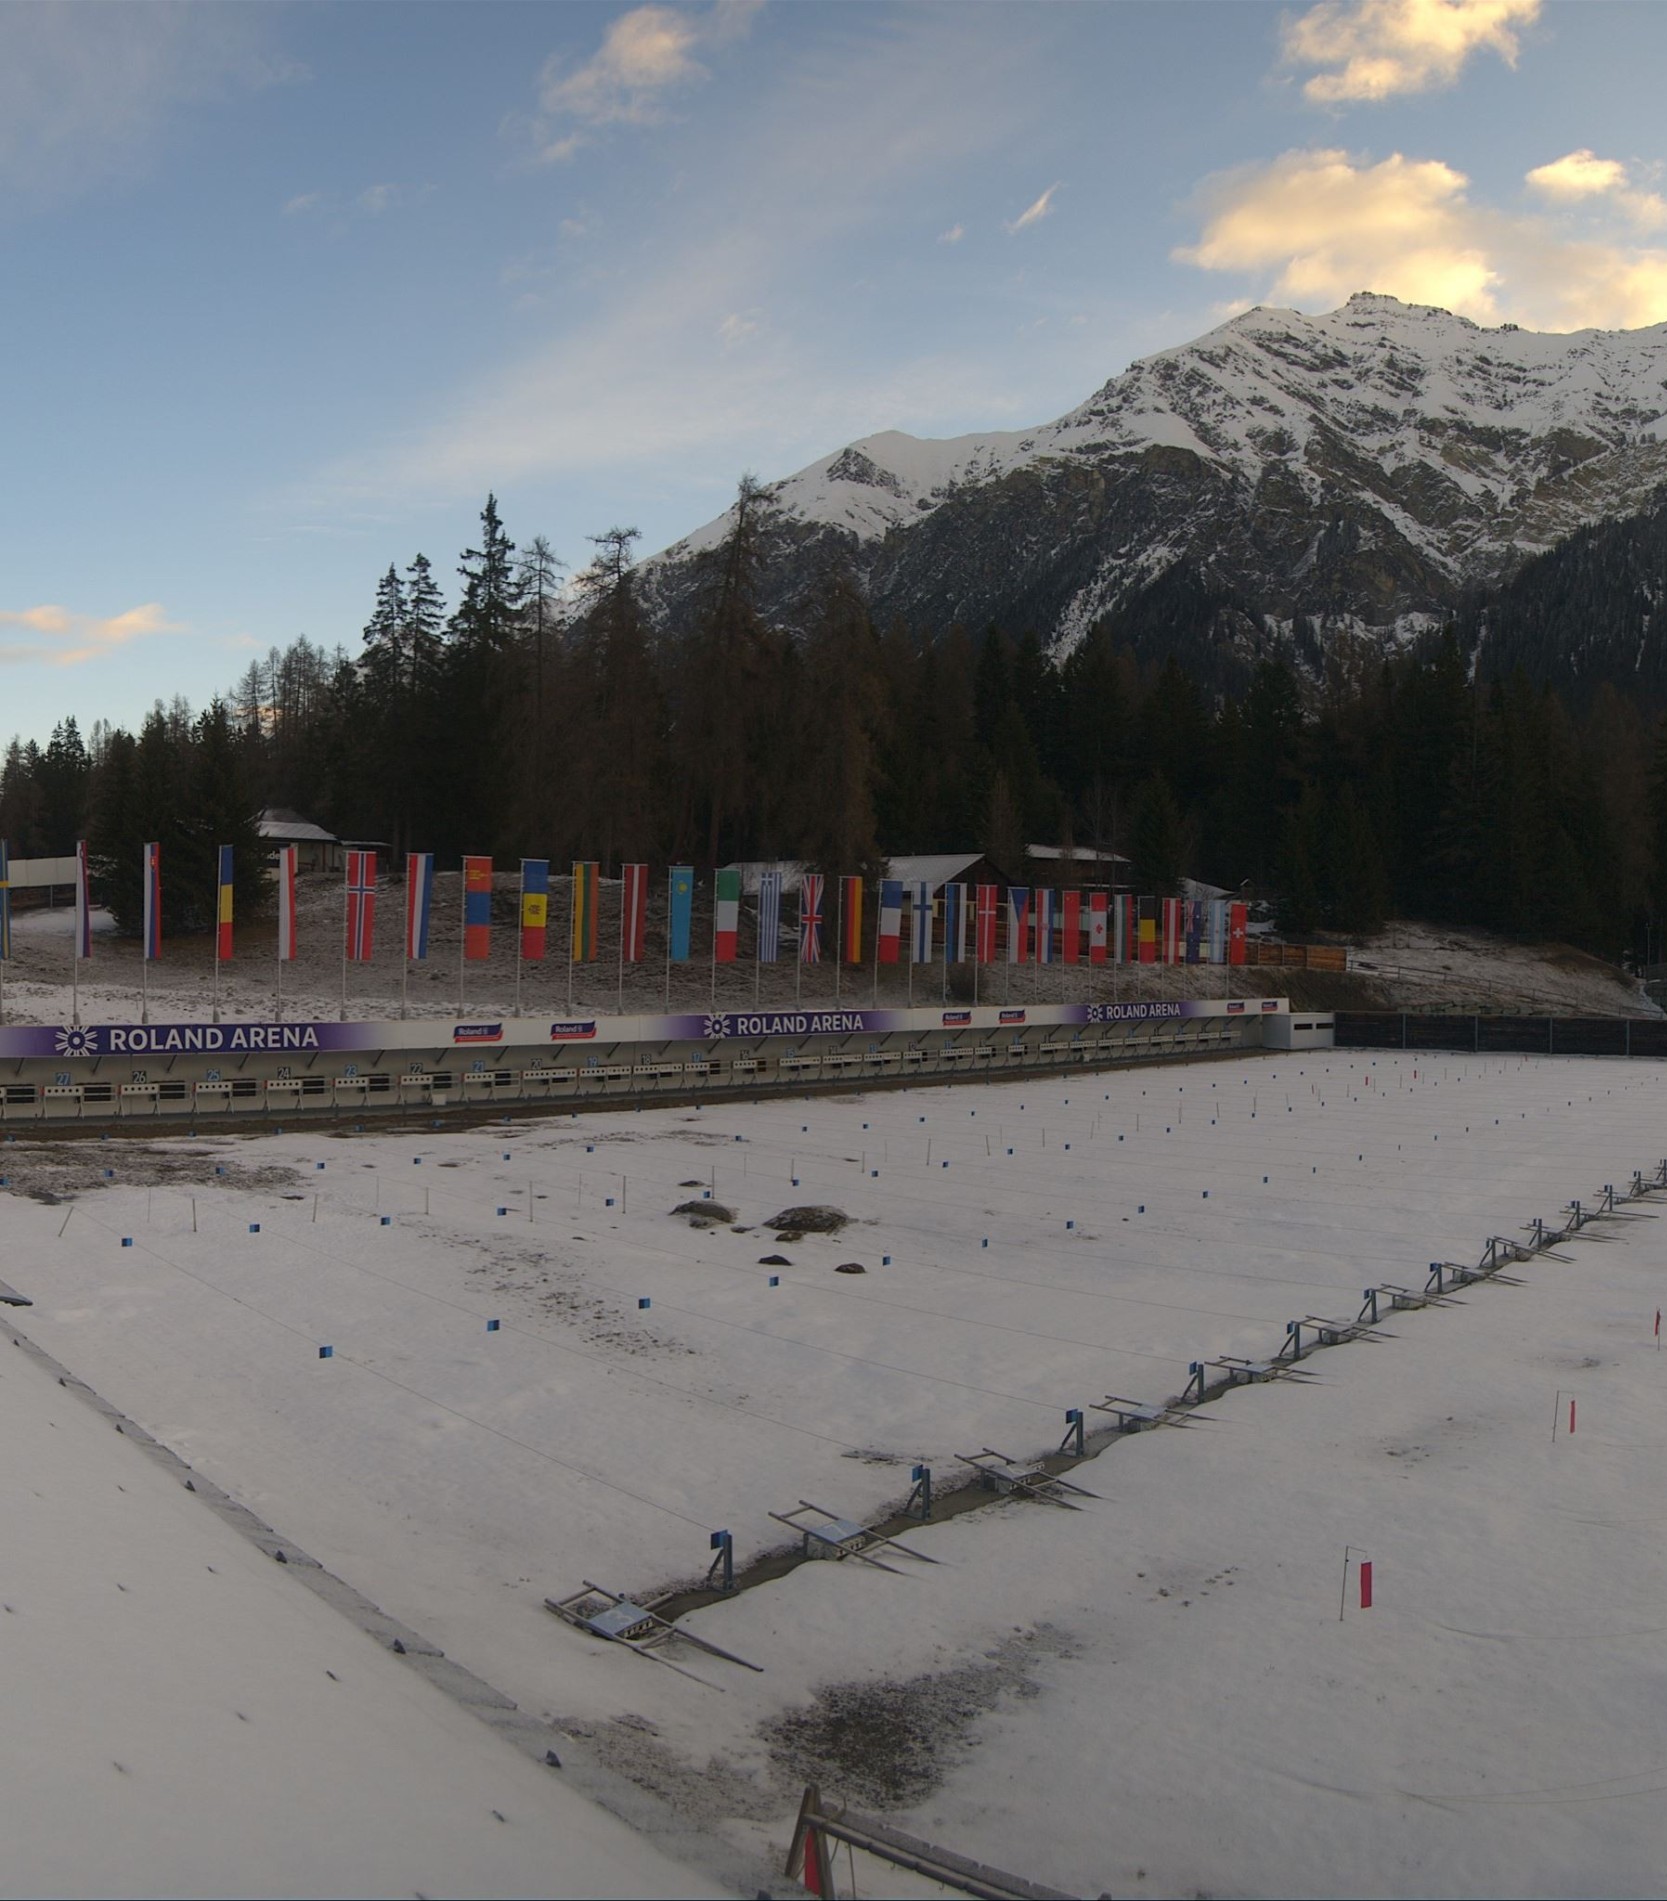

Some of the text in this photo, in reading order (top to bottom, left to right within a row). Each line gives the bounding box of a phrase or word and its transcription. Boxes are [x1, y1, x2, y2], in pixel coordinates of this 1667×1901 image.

[1106, 1002, 1181, 1020] ROLAND ARENA
[736, 1013, 863, 1036] ROLAND ARENA
[109, 1025, 320, 1053] ROLAND ARENA
[207, 1070, 220, 1081] 25
[278, 1068, 291, 1080] 24
[345, 1065, 358, 1077] 23
[411, 1064, 423, 1075] 22
[57, 1073, 70, 1086] 27
[132, 1071, 146, 1083] 26
